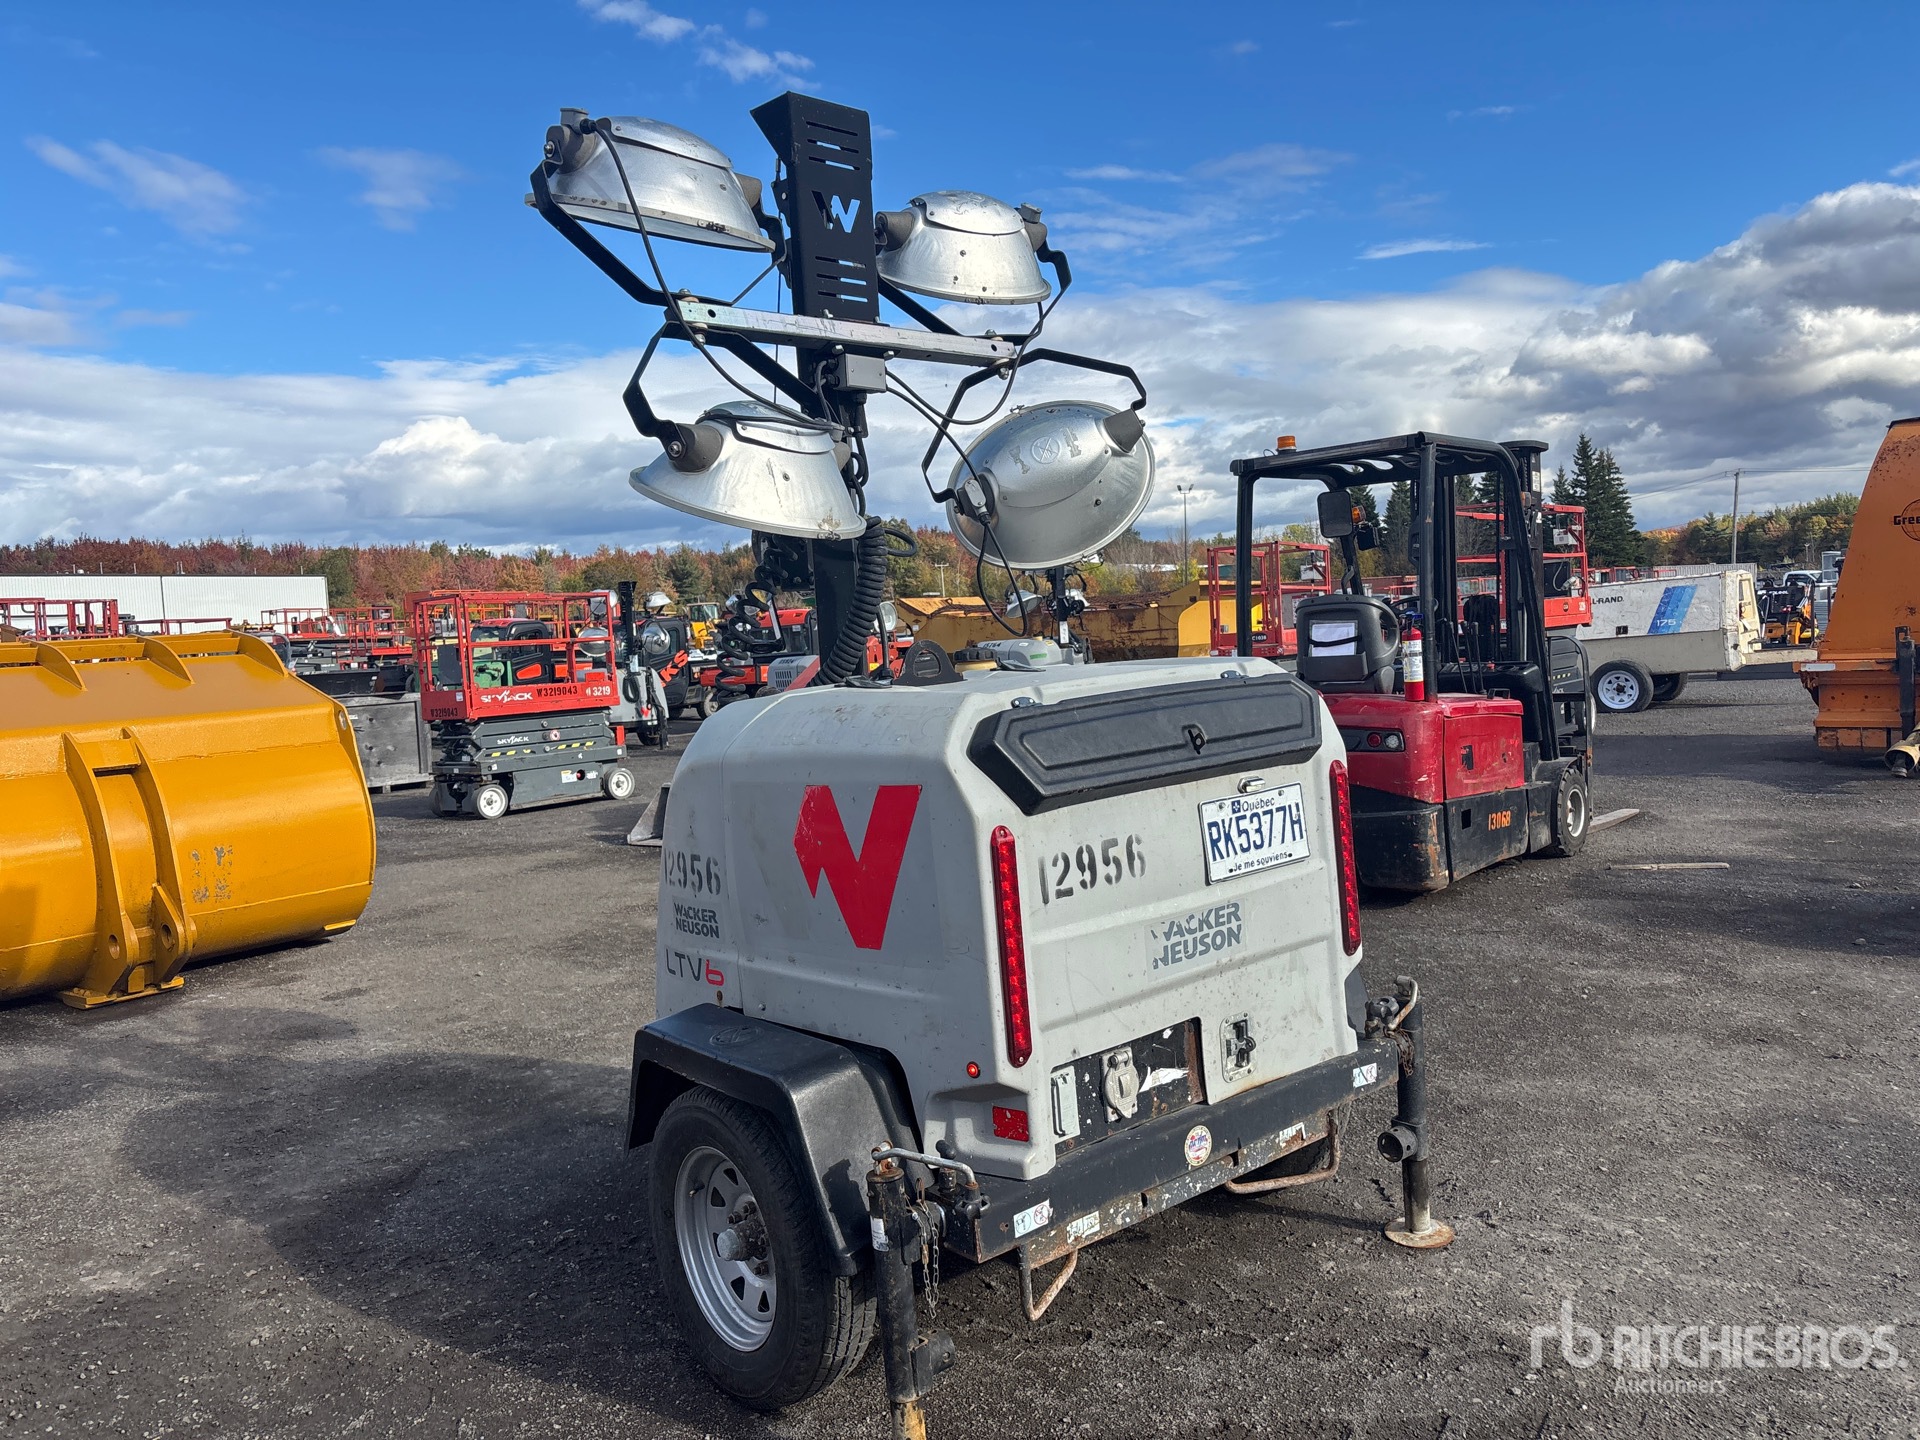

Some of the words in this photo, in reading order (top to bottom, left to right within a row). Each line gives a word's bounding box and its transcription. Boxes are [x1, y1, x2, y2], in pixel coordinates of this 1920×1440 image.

[1656, 618, 1677, 627] 175
[536, 685, 578, 697] W3219043
[592, 685, 611, 697] 3219
[1241, 797, 1276, 813] Québec
[1207, 802, 1304, 862] RK5377H
[1488, 811, 1511, 831] 13068
[664, 848, 721, 896] 12956
[1037, 834, 1146, 905] 12956
[1233, 862, 1243, 873] Je
[1244, 859, 1256, 869] me
[1256, 851, 1289, 866] souviens
[674, 902, 719, 925] WACKER
[675, 917, 720, 939] NEUSON
[665, 947, 725, 987] LTV6
